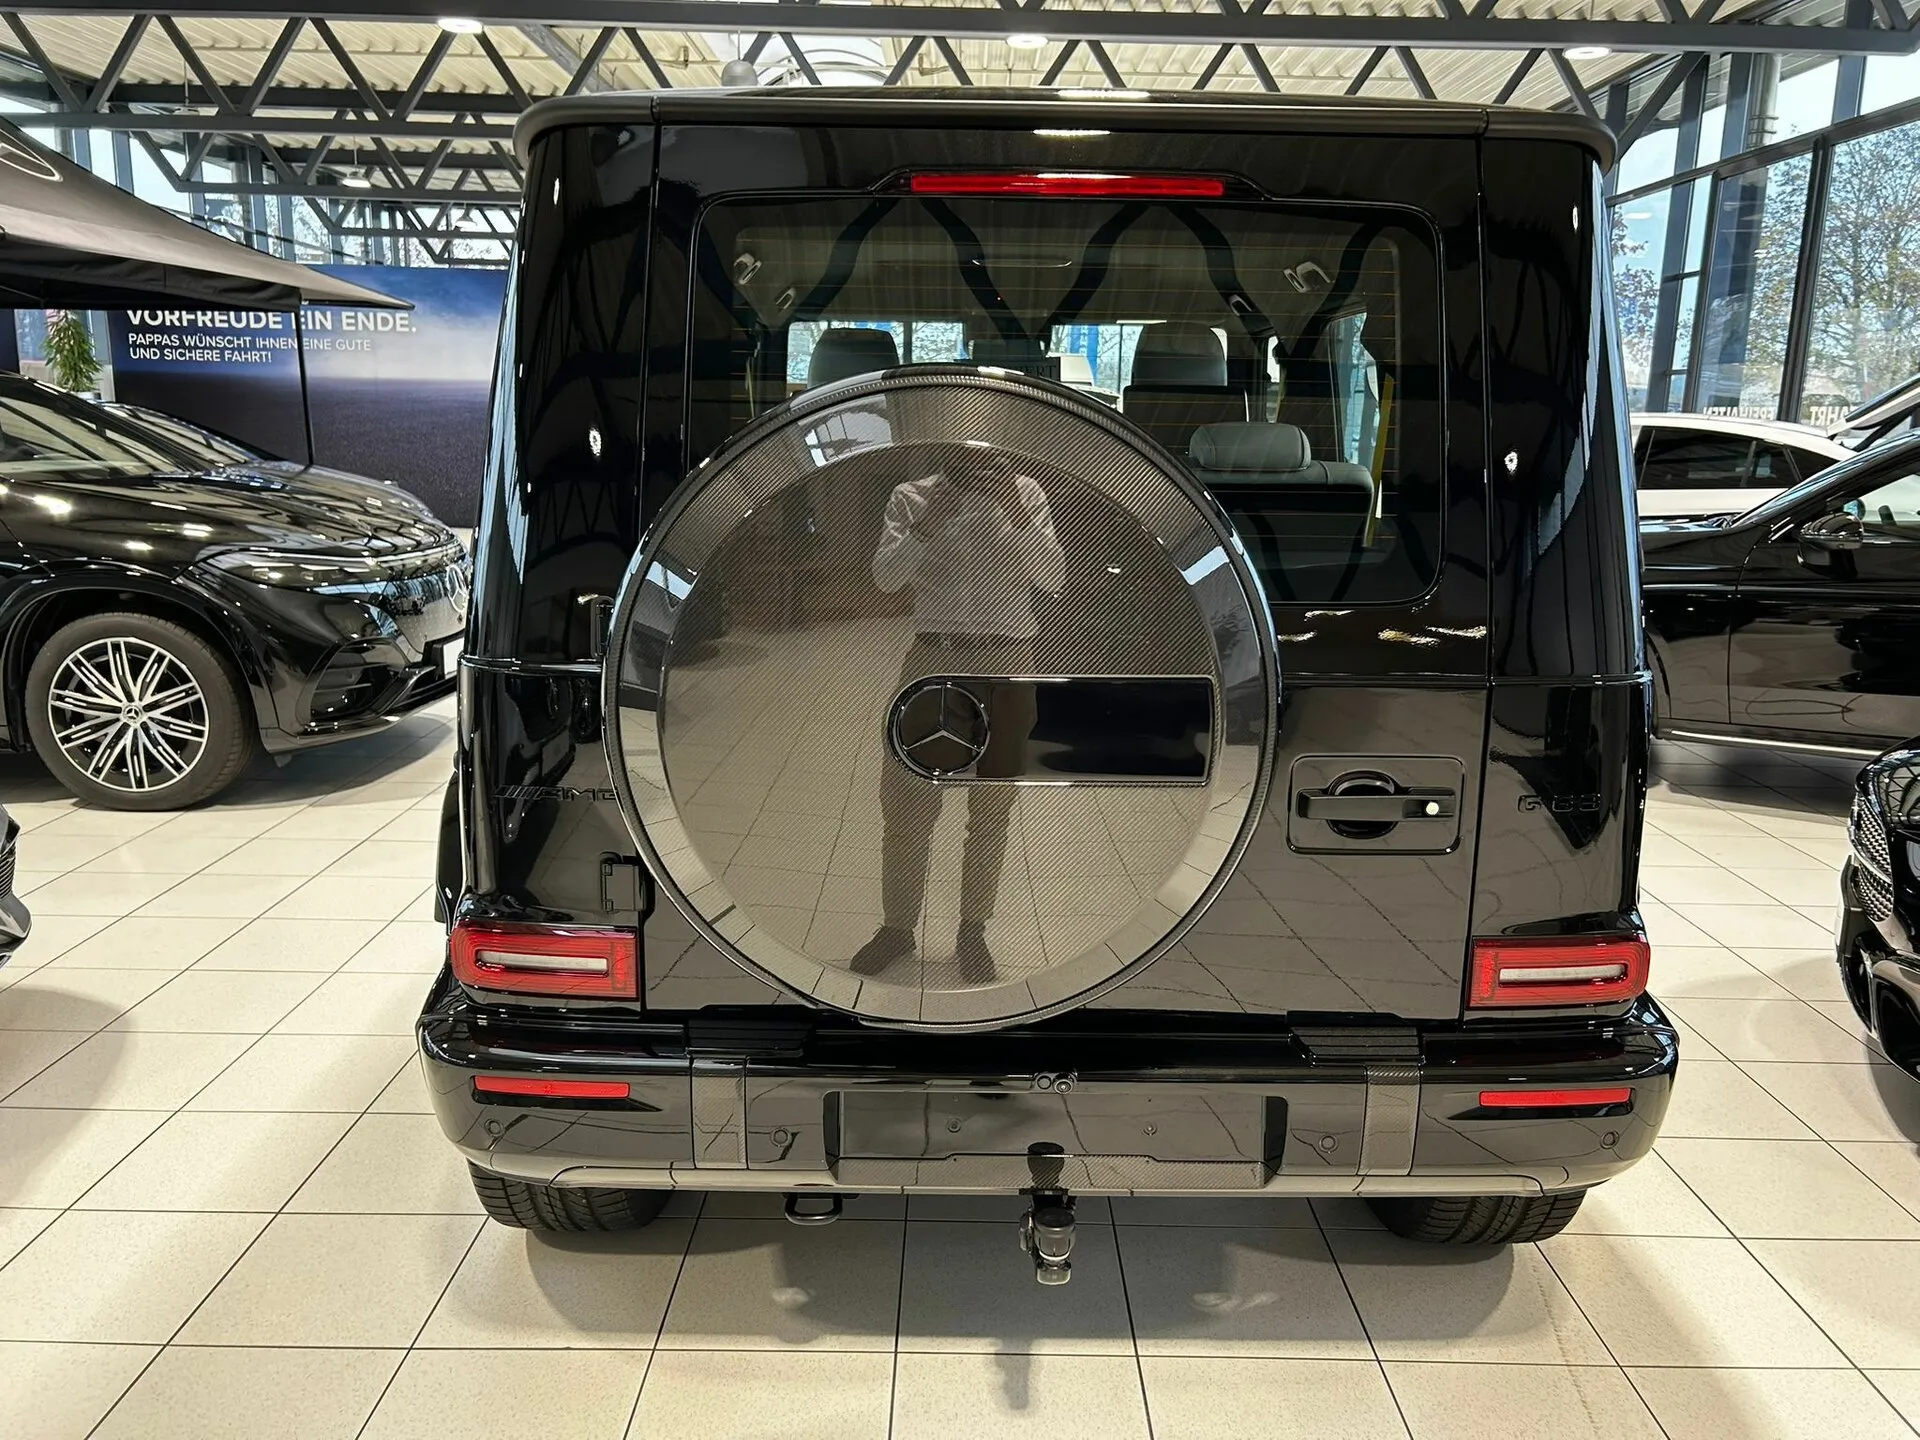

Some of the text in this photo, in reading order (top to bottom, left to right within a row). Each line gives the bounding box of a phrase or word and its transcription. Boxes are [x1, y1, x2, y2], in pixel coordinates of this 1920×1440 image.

[127, 310, 282, 329] VORFREUDE
[341, 311, 417, 333] ENDE.
[128, 333, 371, 351] PAPPAS WÜNSCHT IHNEN EINE GUTE
[130, 347, 272, 363] UND SICHERE FAHRT!
